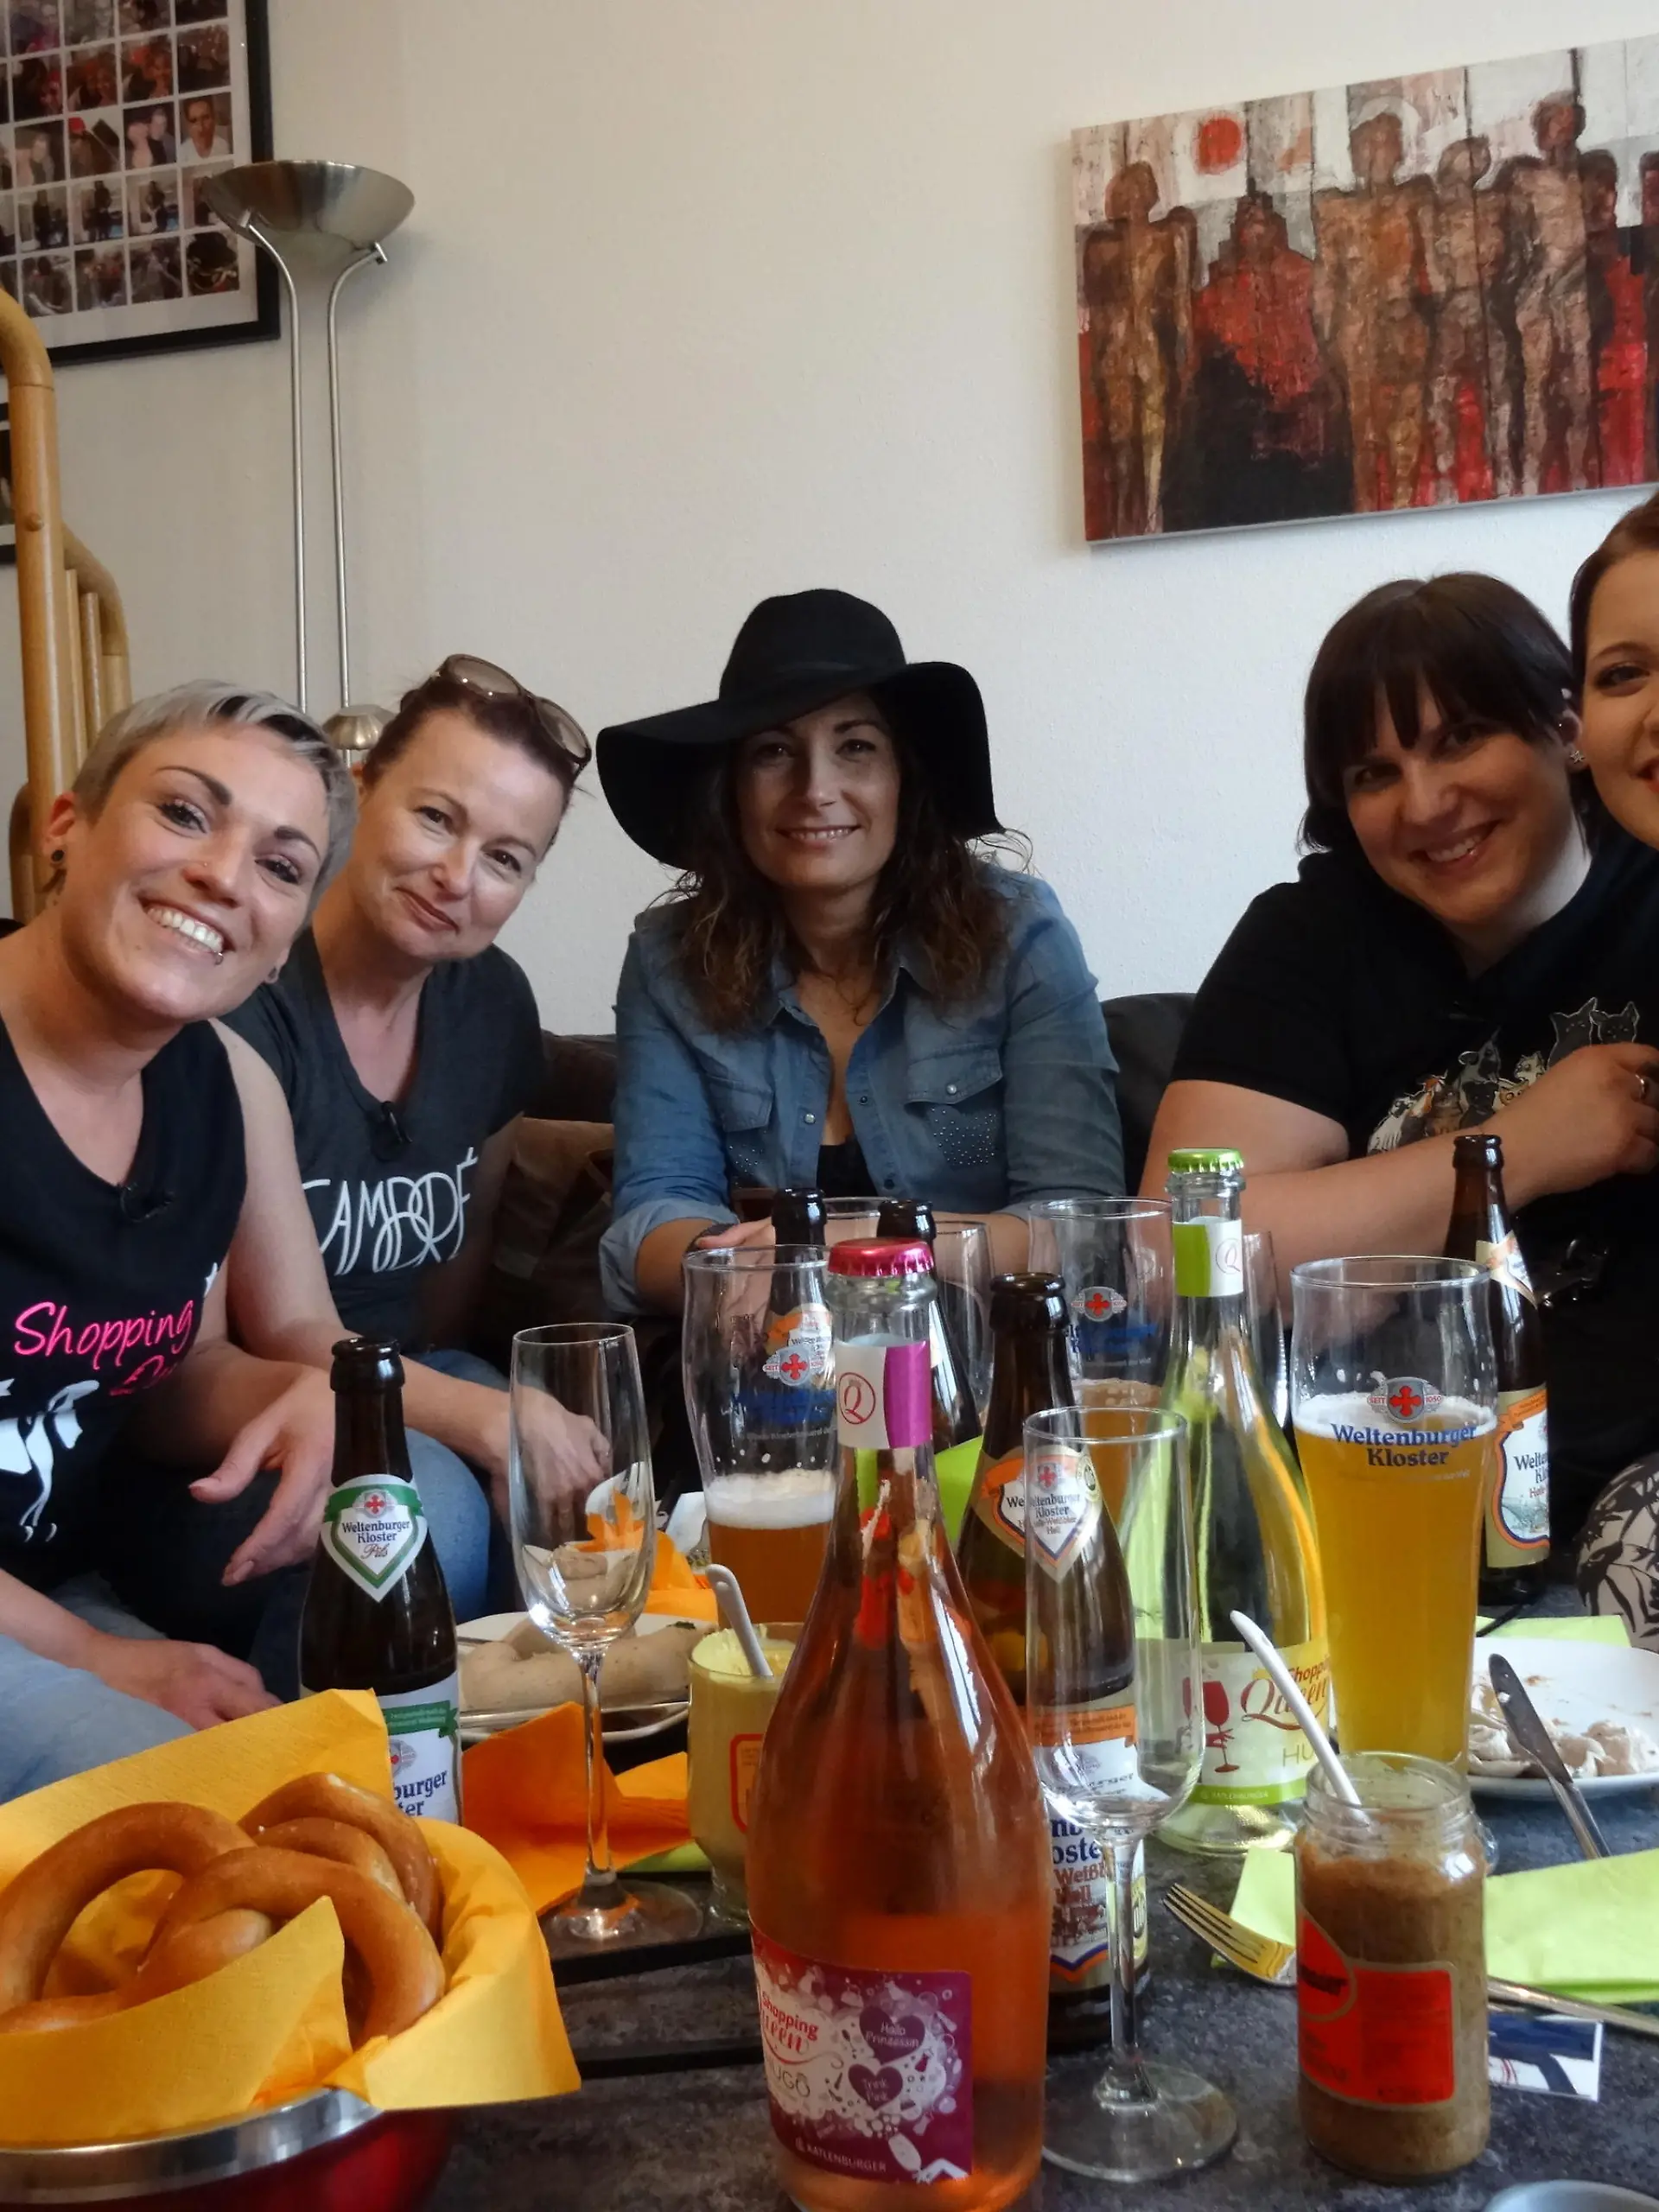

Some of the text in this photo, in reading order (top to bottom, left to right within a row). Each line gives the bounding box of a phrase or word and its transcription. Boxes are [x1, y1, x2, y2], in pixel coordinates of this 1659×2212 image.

[14, 1300, 194, 1370] Shopping
[1332, 1423, 1478, 1447] Weltenburger
[1367, 1448, 1450, 1467] Kloster
[340, 1518, 410, 1535] Weltenburger
[357, 1531, 397, 1544] Kloster
[359, 1543, 390, 1560] Pils
